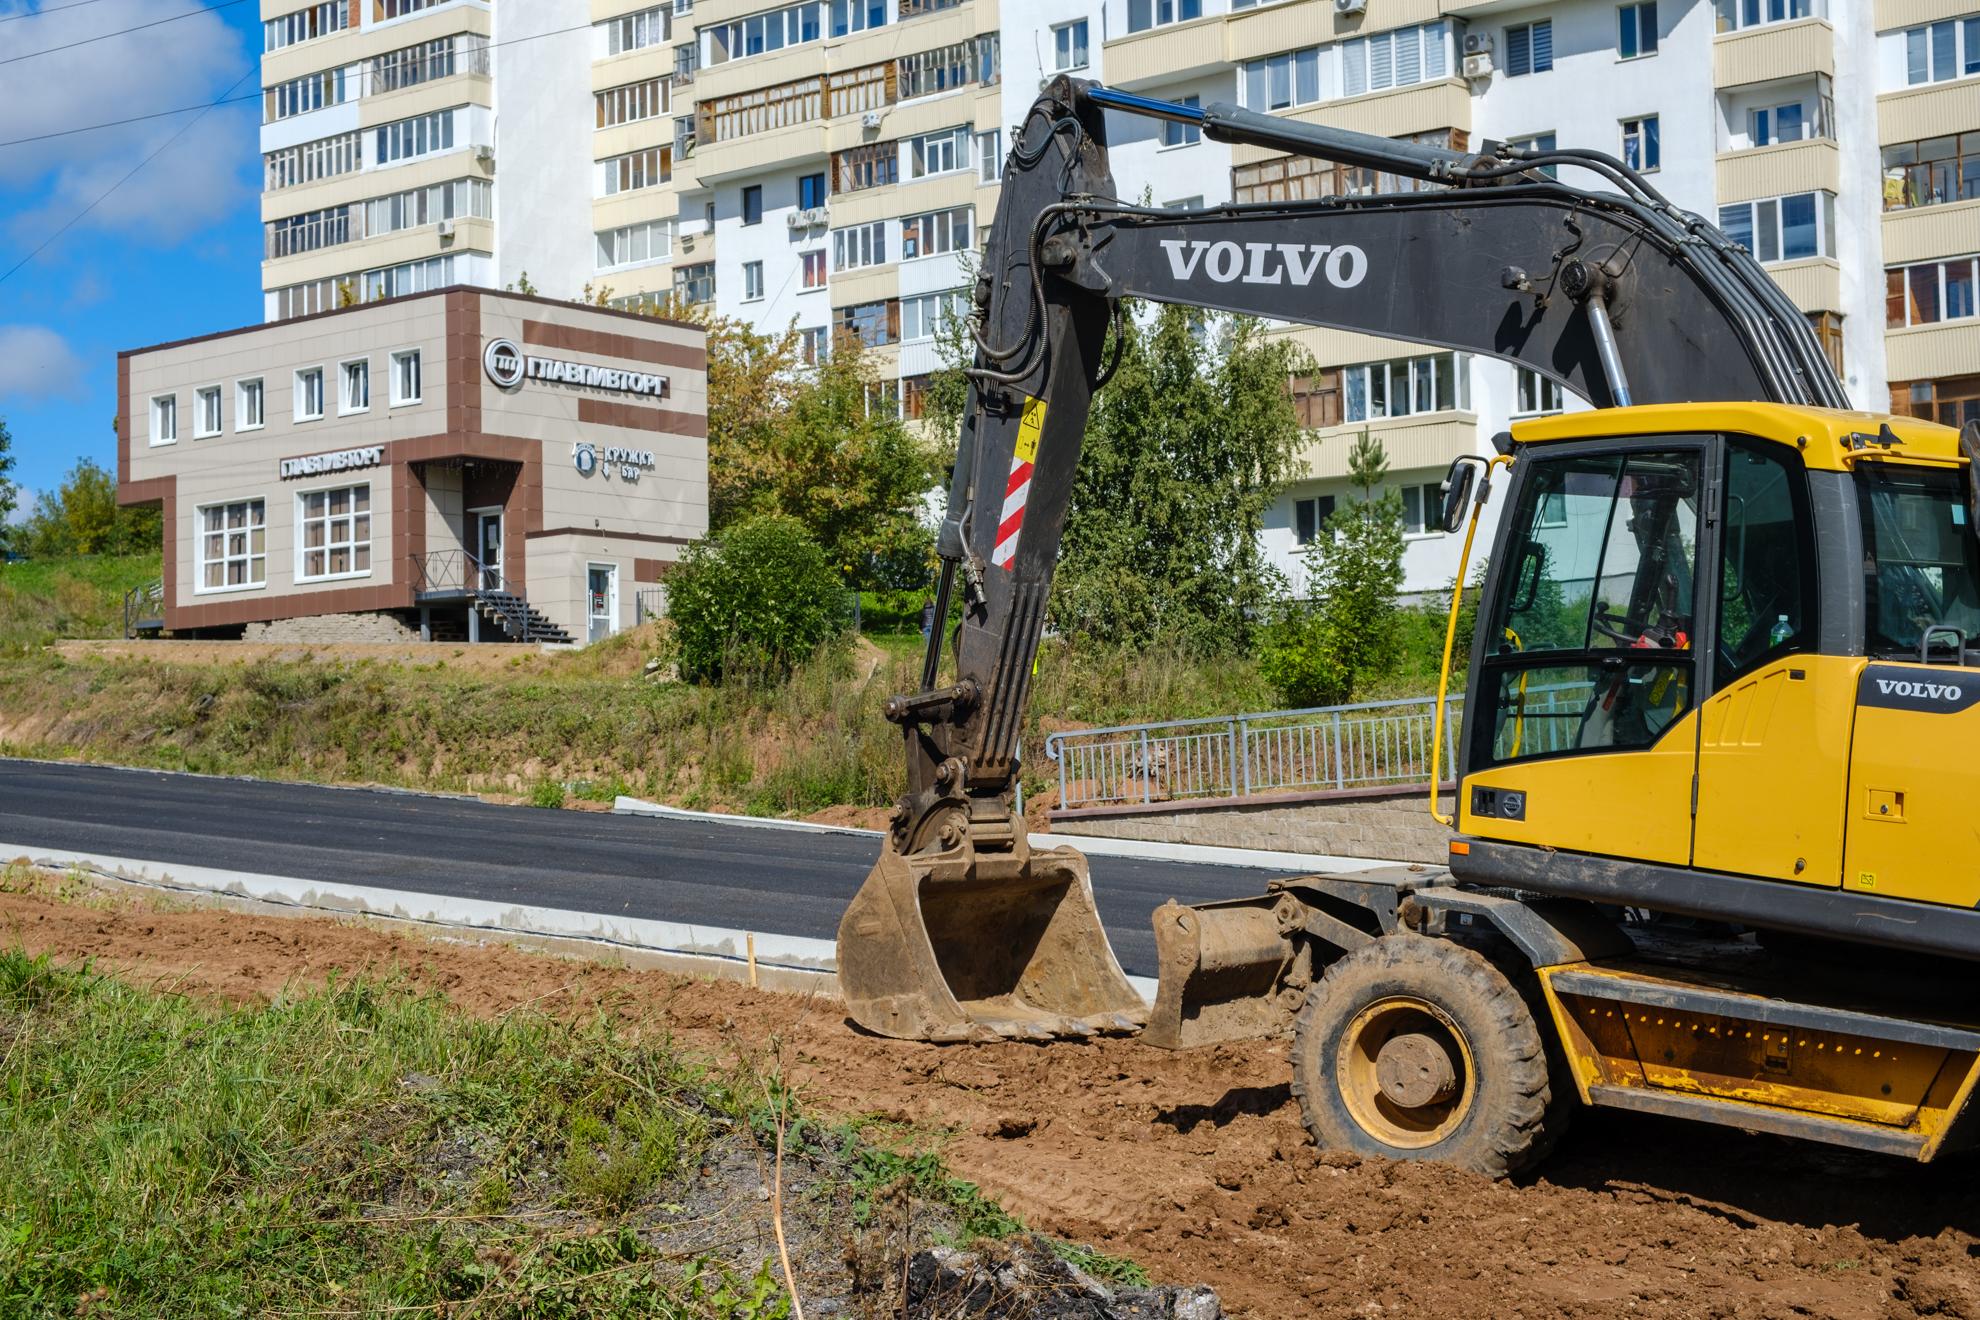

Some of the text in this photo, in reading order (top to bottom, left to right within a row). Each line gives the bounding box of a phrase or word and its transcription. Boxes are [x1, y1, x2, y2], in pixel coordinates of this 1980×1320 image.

[1160, 239, 1368, 289] VOLVO
[527, 356, 667, 395] ГЛАВПИВТОРГ
[604, 447, 655, 466] КРУЖКА
[621, 464, 640, 480] БАР
[1876, 679, 1962, 701] VOLVO
